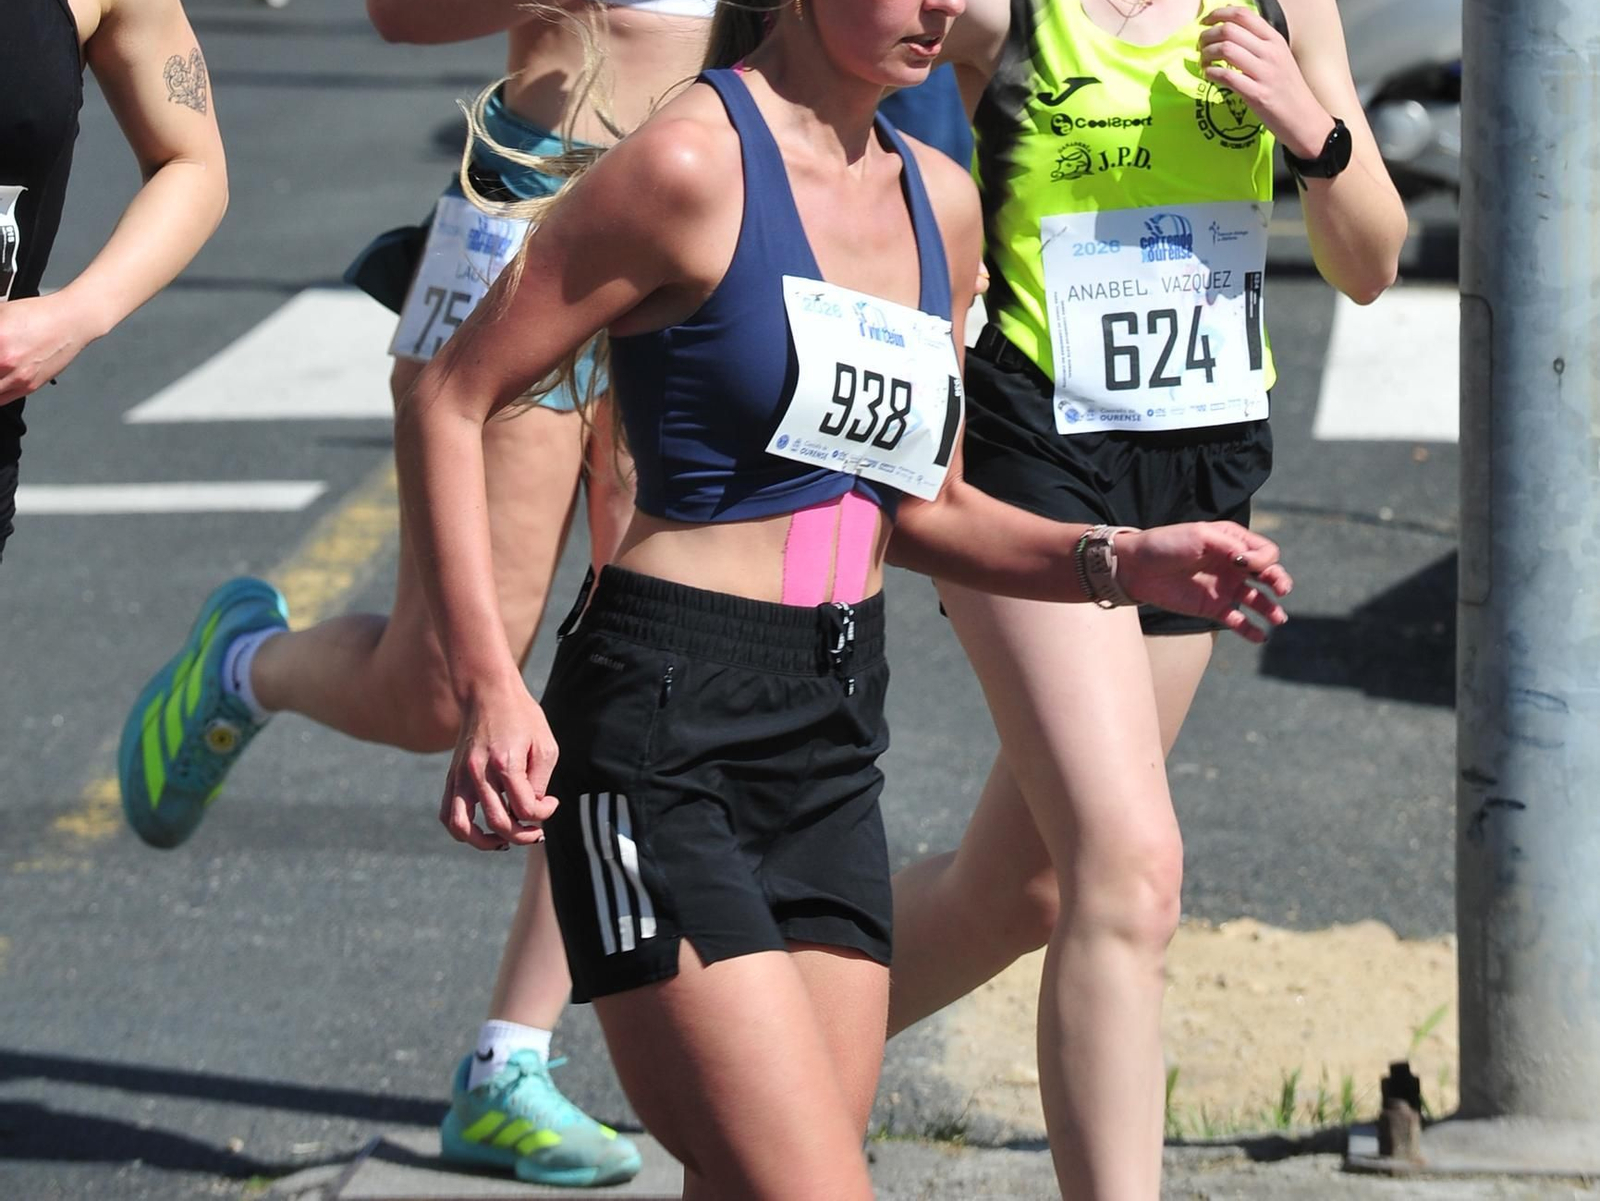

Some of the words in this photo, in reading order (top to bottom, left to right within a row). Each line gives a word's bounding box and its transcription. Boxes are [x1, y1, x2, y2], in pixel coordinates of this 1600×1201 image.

[1098, 146, 1152, 172] J.P.D.
[1067, 279, 1148, 302] ANABEL
[1161, 270, 1232, 294] VAZQUEZ
[1101, 305, 1217, 392] 624
[819, 361, 912, 451] 938
[1099, 413, 1142, 423] OURENSE
